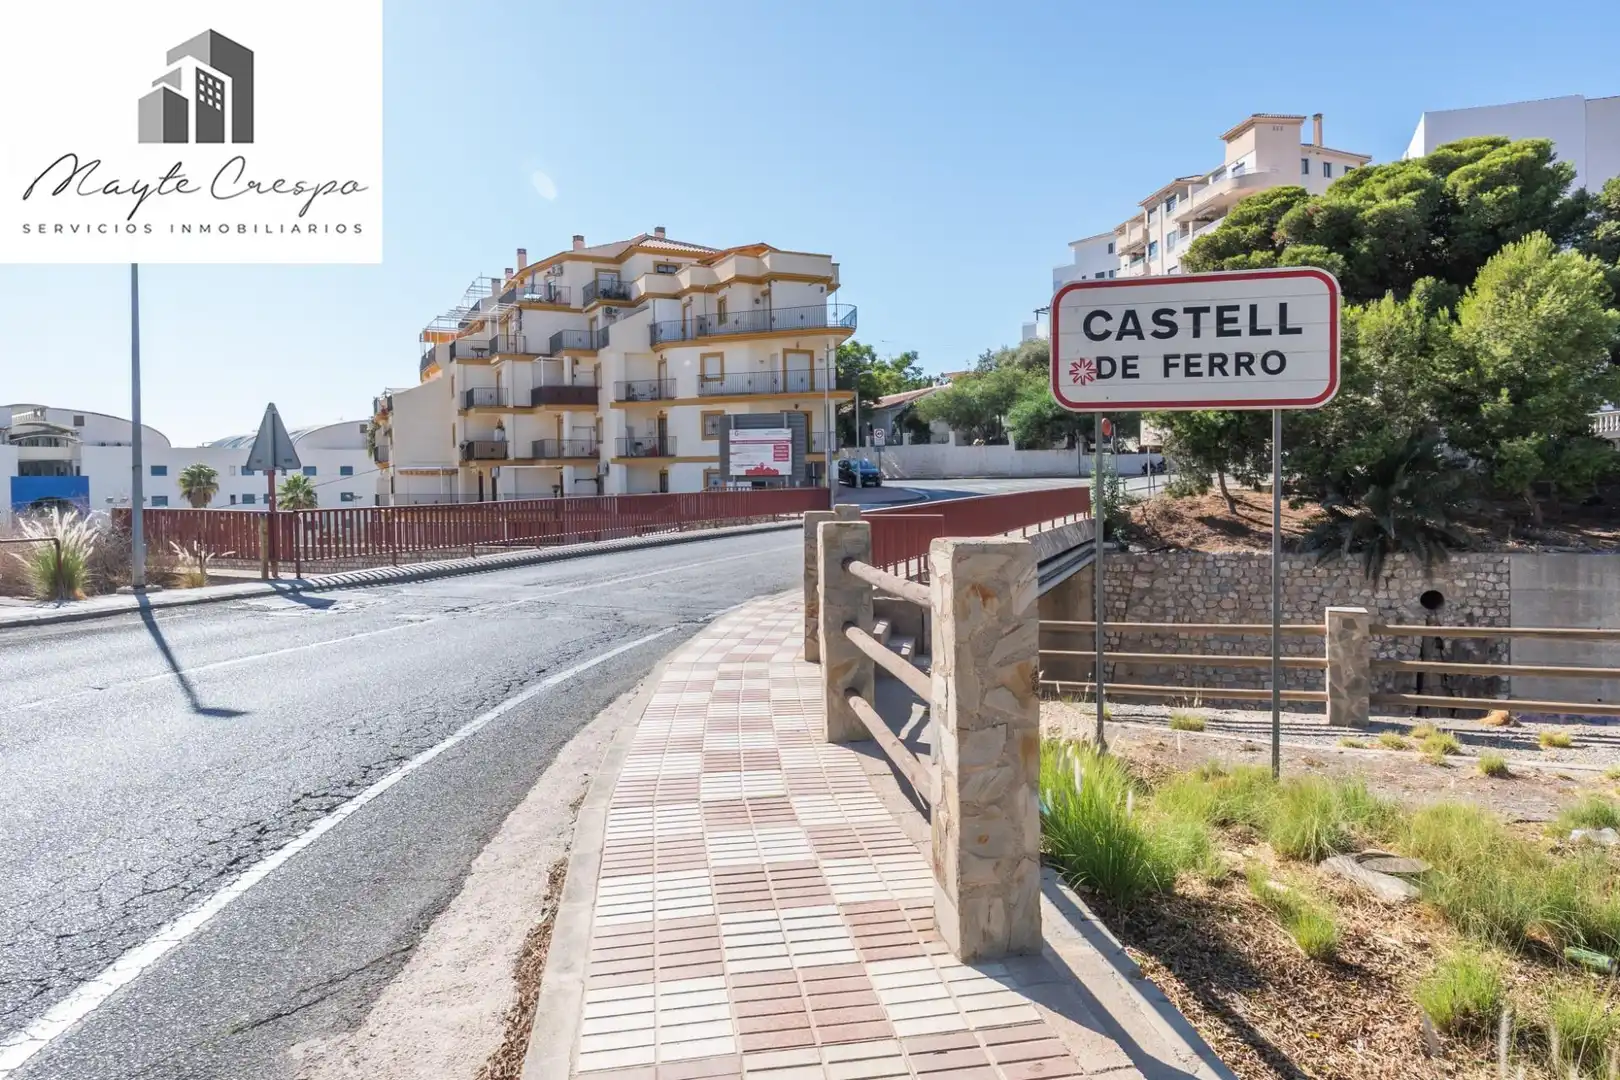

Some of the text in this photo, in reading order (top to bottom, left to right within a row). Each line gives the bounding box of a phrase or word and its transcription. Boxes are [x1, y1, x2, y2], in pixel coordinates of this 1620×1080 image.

[1082, 302, 1303, 342] CASTELL
[1095, 350, 1287, 380] DE FERRO
